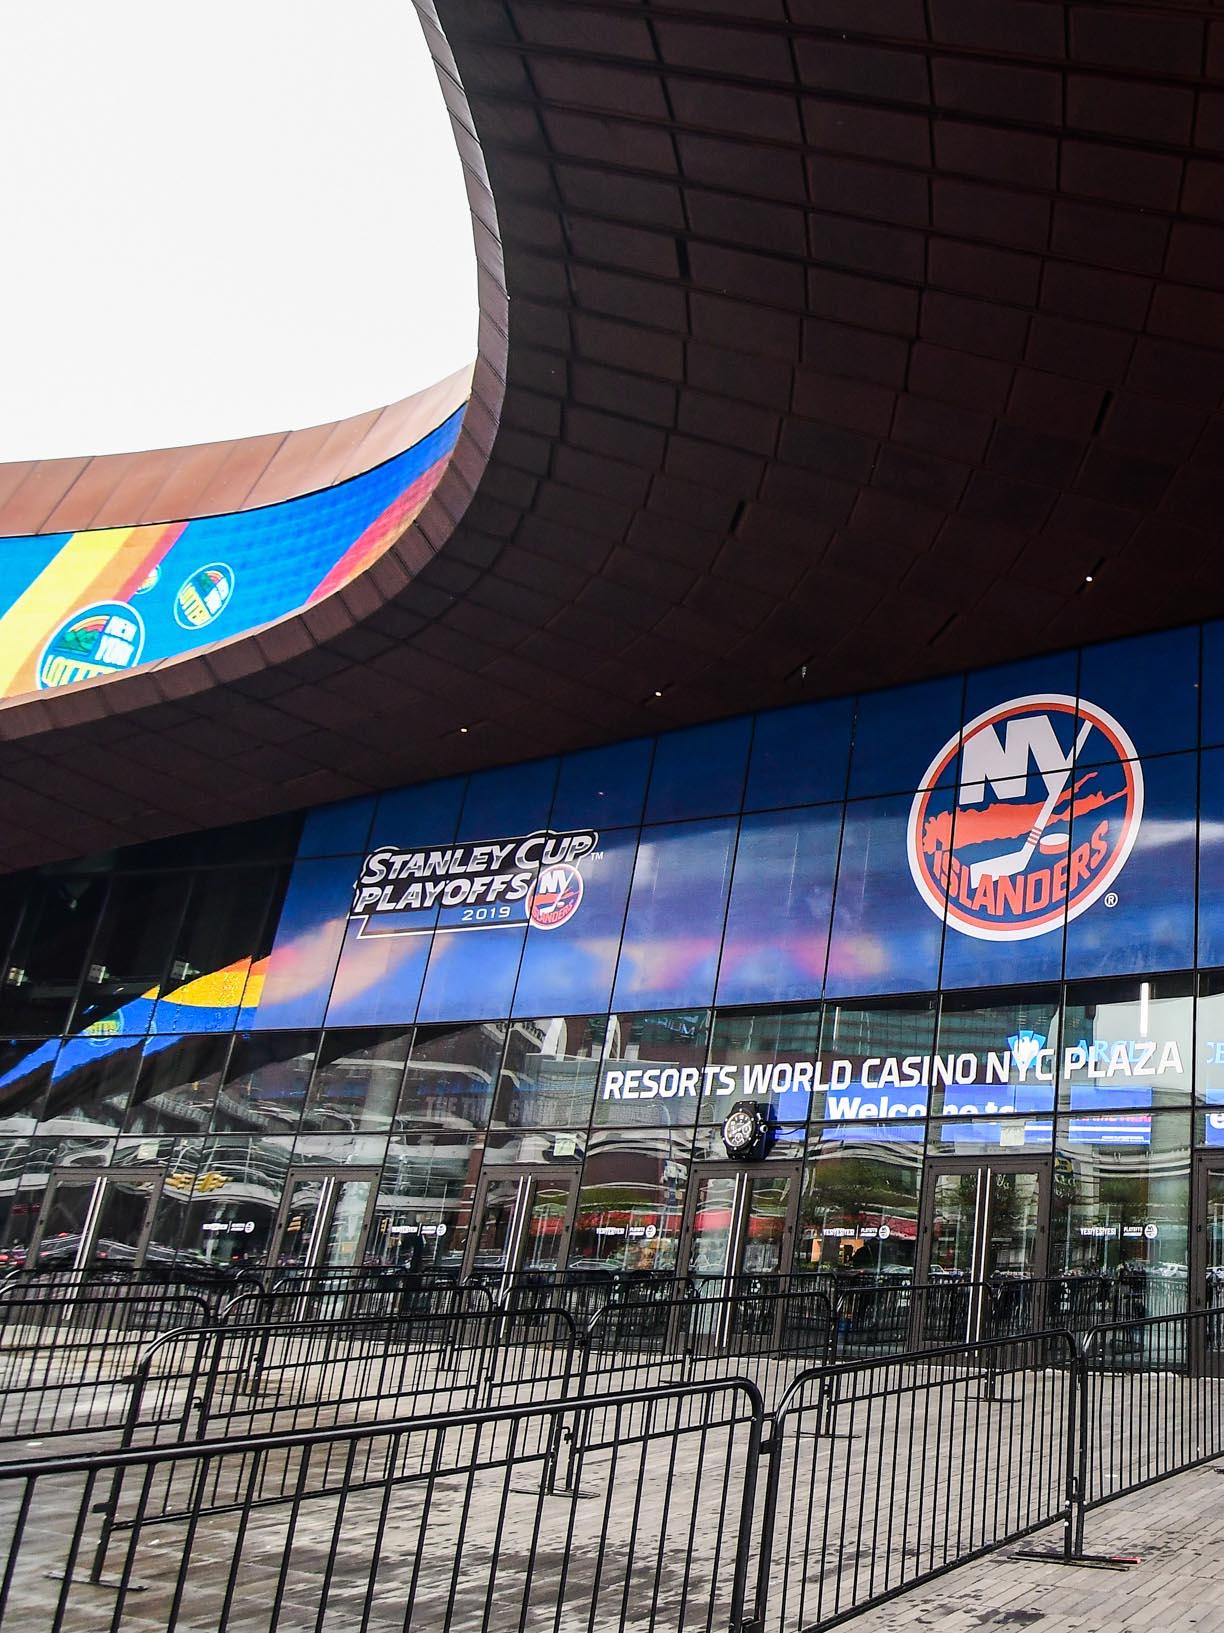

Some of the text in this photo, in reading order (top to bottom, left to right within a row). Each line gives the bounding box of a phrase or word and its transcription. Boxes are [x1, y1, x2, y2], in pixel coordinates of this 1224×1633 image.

[361, 835, 592, 884] STANLEY CUP
[933, 820, 1108, 915] ISLANDERS
[354, 872, 532, 912] PLAYOFFS
[462, 906, 511, 921] 2019
[603, 1065, 737, 1100] RESORTS
[744, 1060, 851, 1095] WORLD
[862, 1053, 977, 1089] CASINO
[986, 1048, 1055, 1083] NYC
[1064, 1041, 1184, 1079] PLAZA
